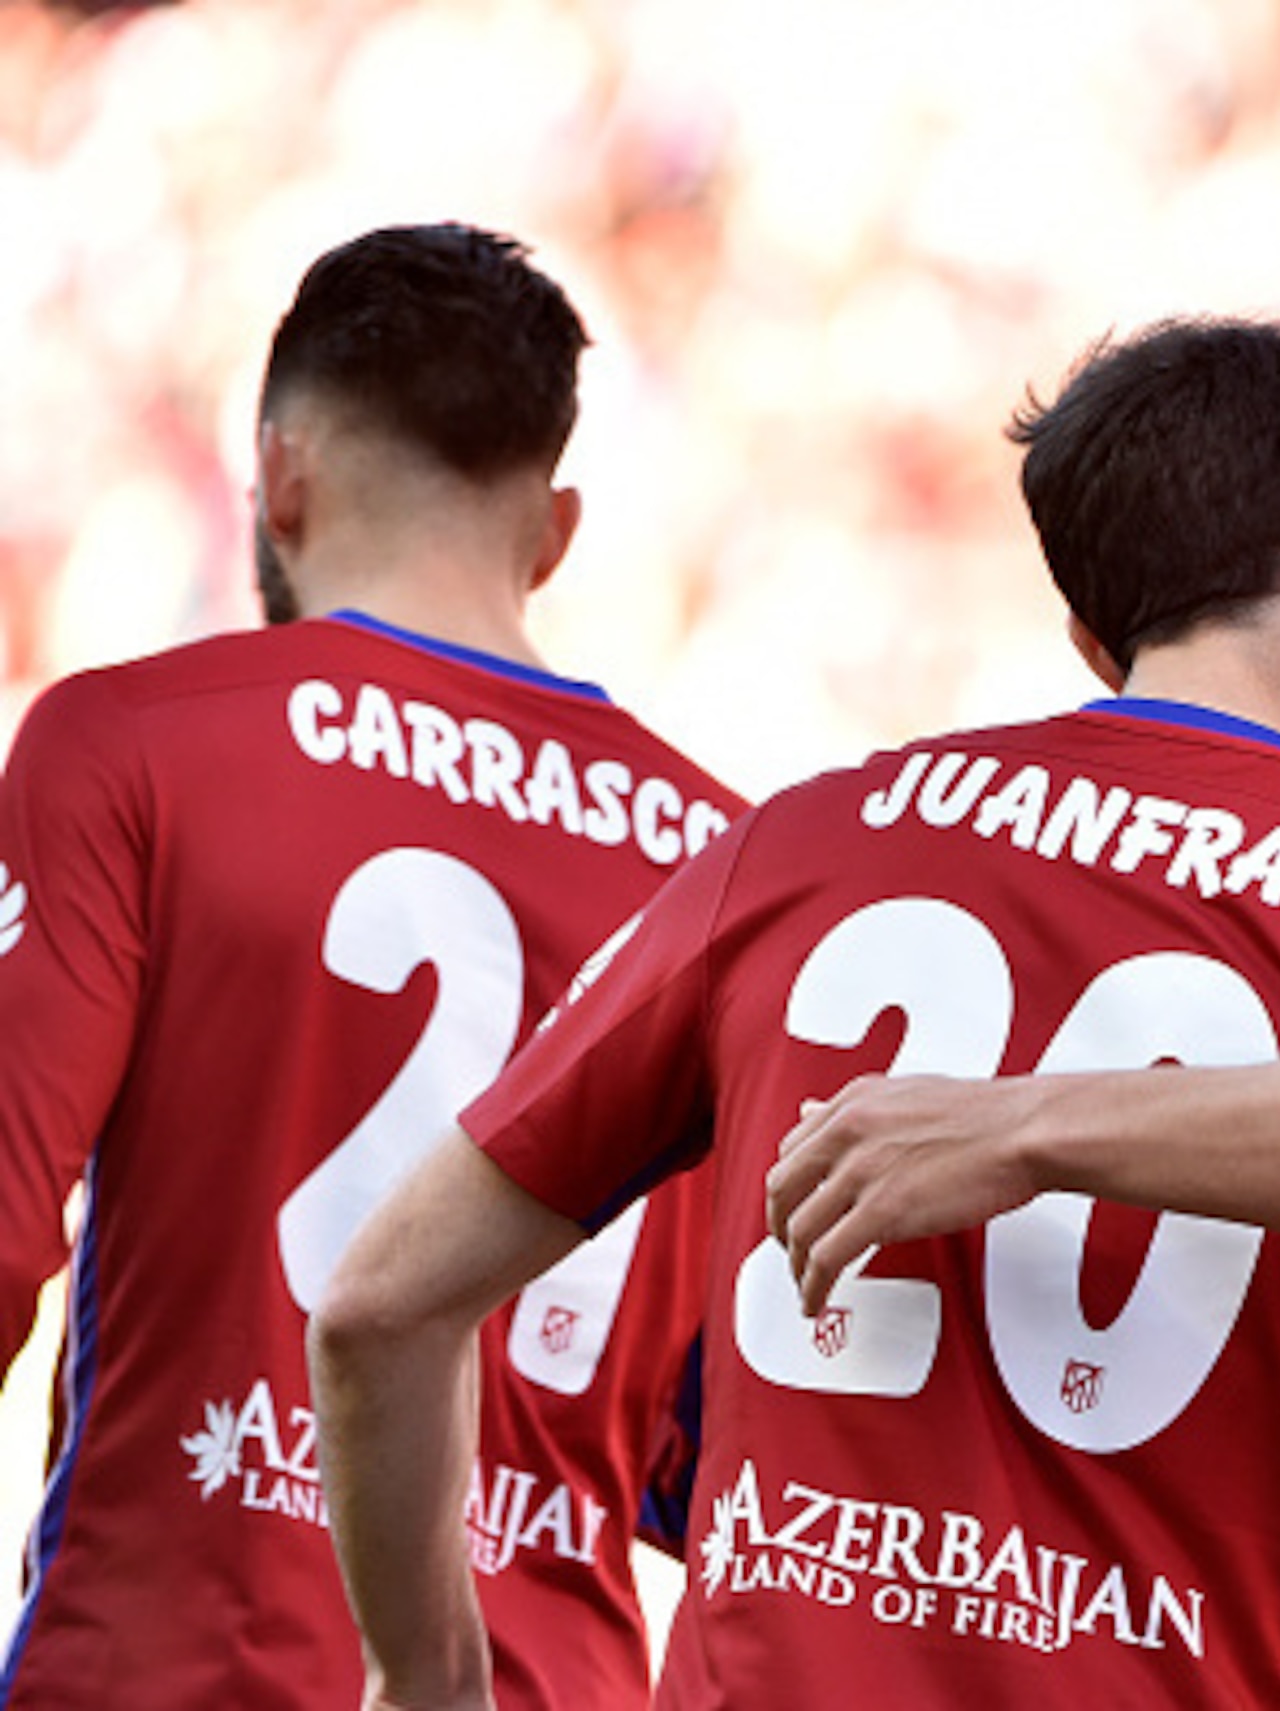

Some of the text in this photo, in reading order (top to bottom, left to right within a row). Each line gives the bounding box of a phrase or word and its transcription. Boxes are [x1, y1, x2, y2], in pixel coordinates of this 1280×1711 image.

[729, 1458, 1205, 1658] AZERBAIJAN
[730, 1552, 1055, 1653] LAND OF FIRE
